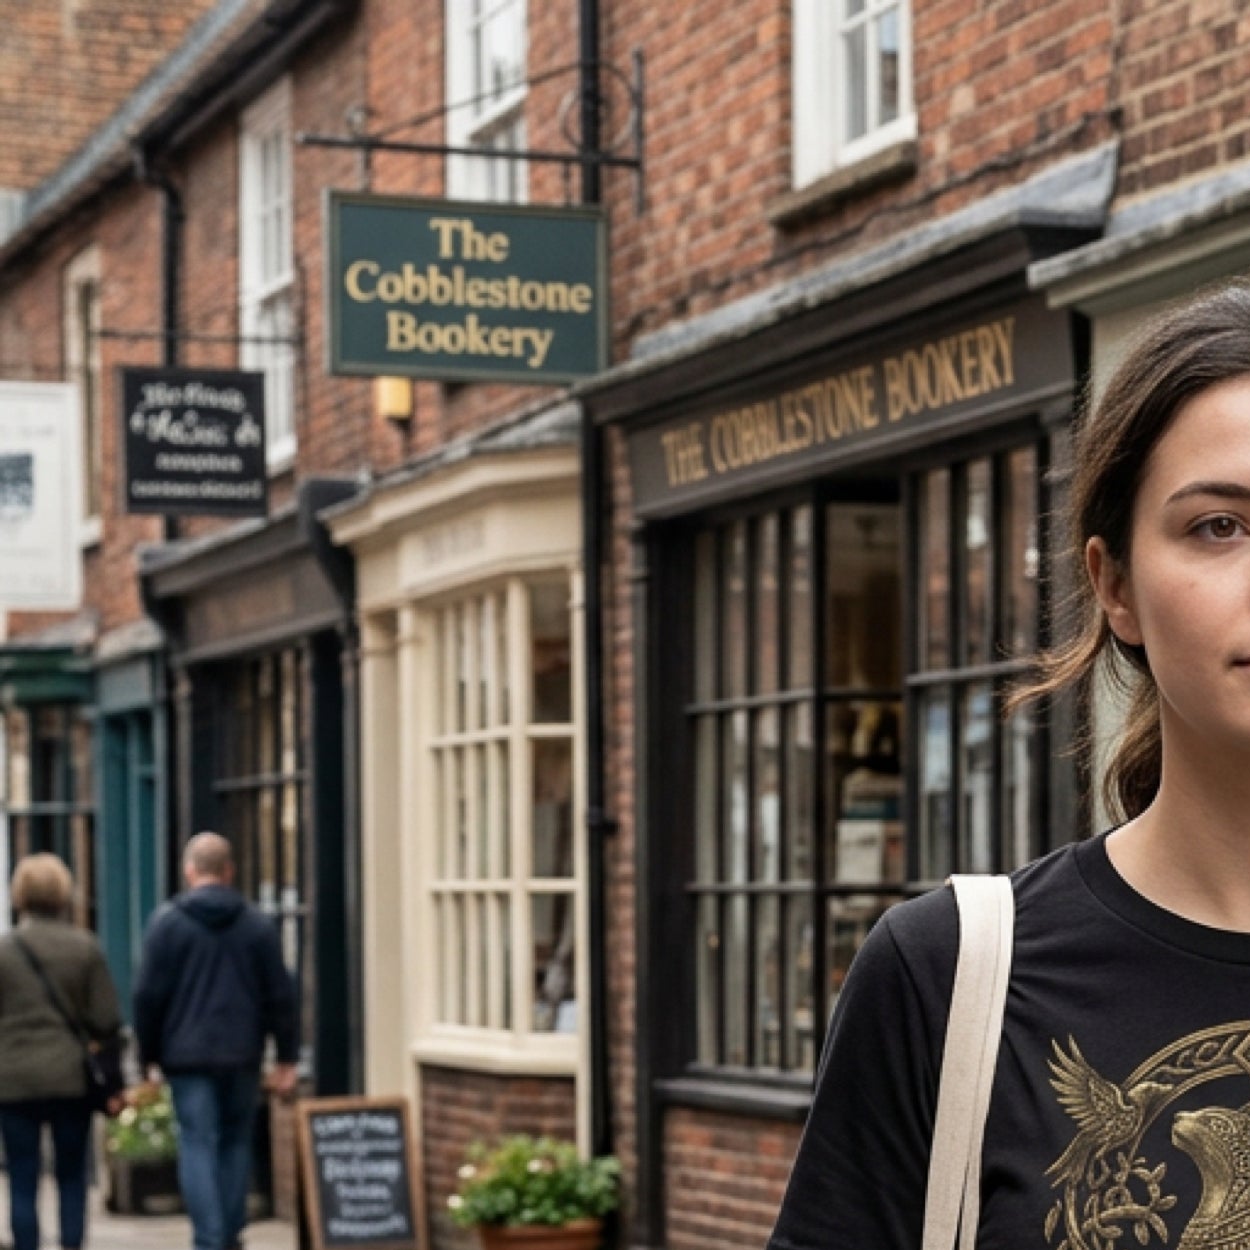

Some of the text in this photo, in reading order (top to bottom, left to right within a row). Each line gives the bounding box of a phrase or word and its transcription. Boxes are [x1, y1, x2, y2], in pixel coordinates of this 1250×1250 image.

[428, 216, 510, 263] The
[344, 259, 593, 314] Cobblestone
[385, 309, 554, 369] Bookery
[661, 316, 1016, 487] THE COBBLESTONE BOOKERY
